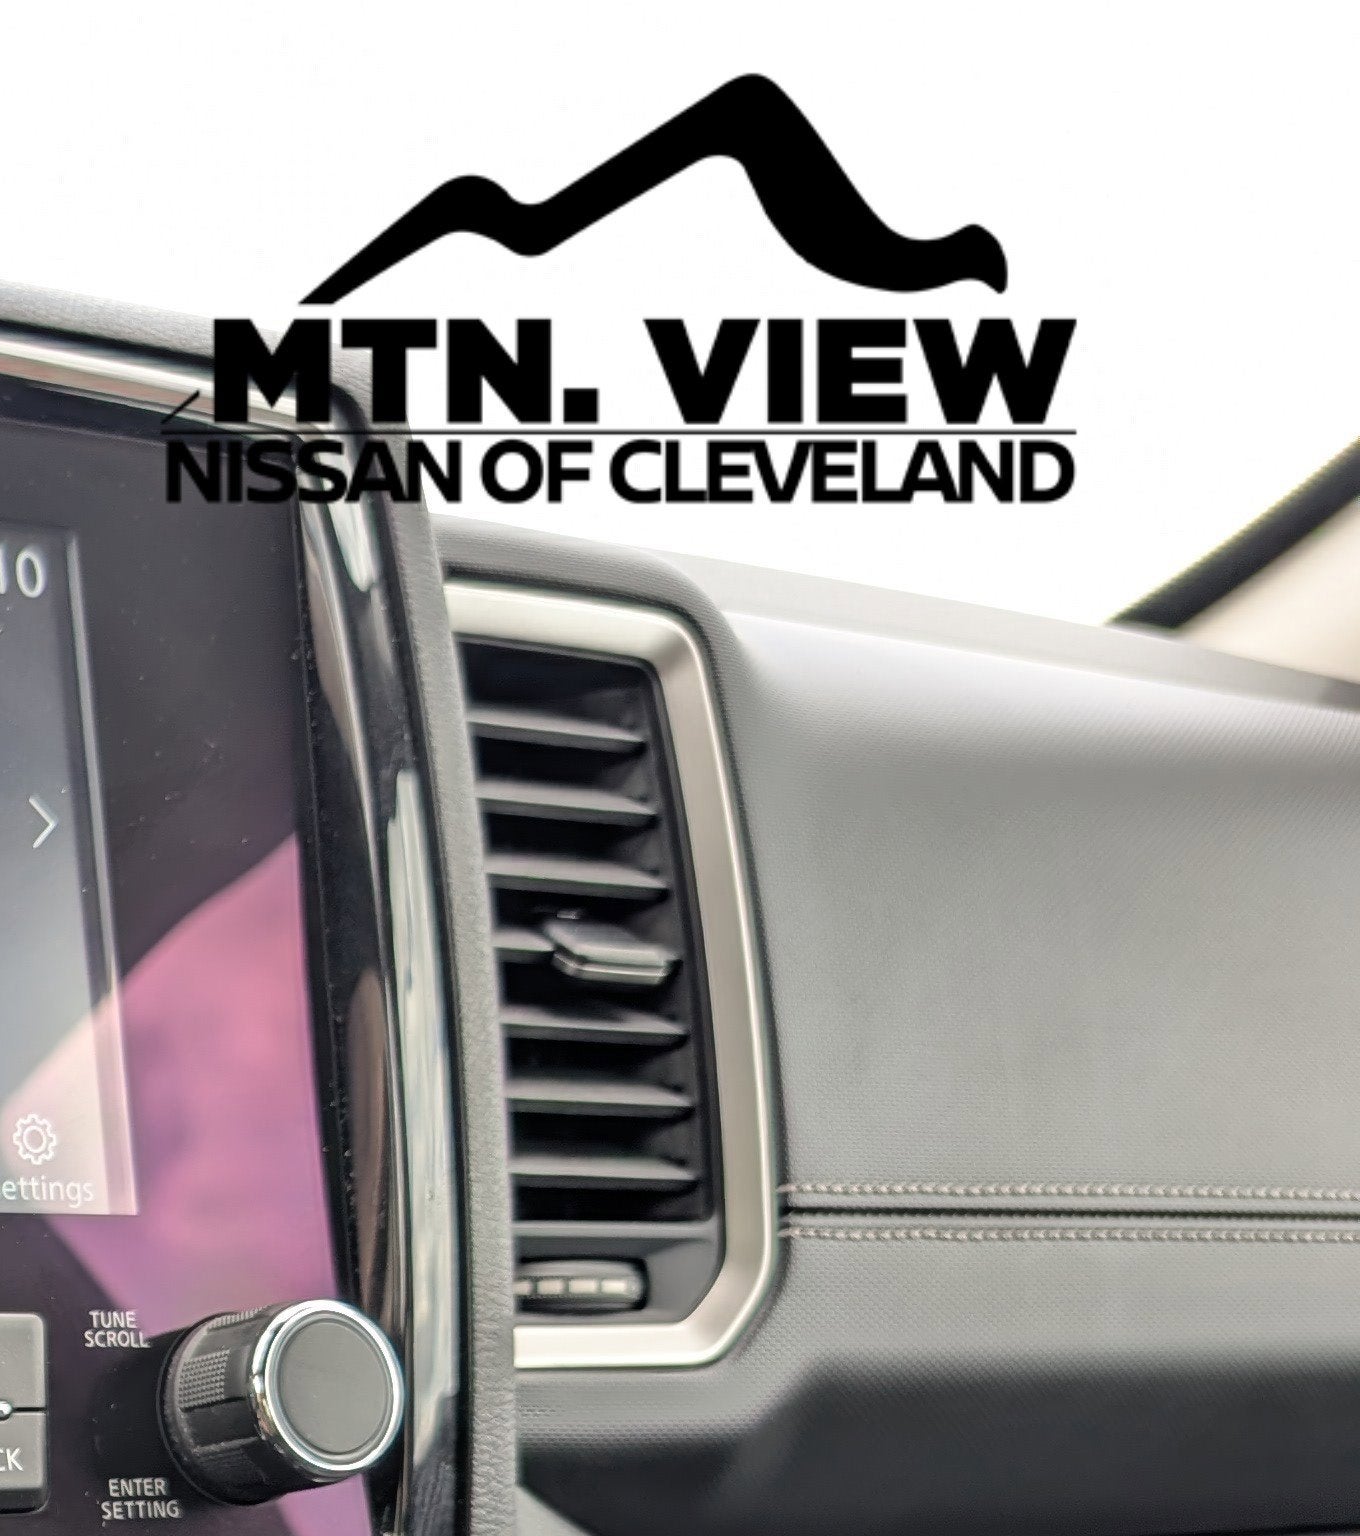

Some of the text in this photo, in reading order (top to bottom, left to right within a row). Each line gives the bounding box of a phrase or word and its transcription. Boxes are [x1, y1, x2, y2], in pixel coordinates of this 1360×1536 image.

[88, 1309, 138, 1329] TUNE
[84, 1330, 152, 1349] SCROLL
[108, 1477, 168, 1497] ENTER
[100, 1500, 180, 1520] SETTING
